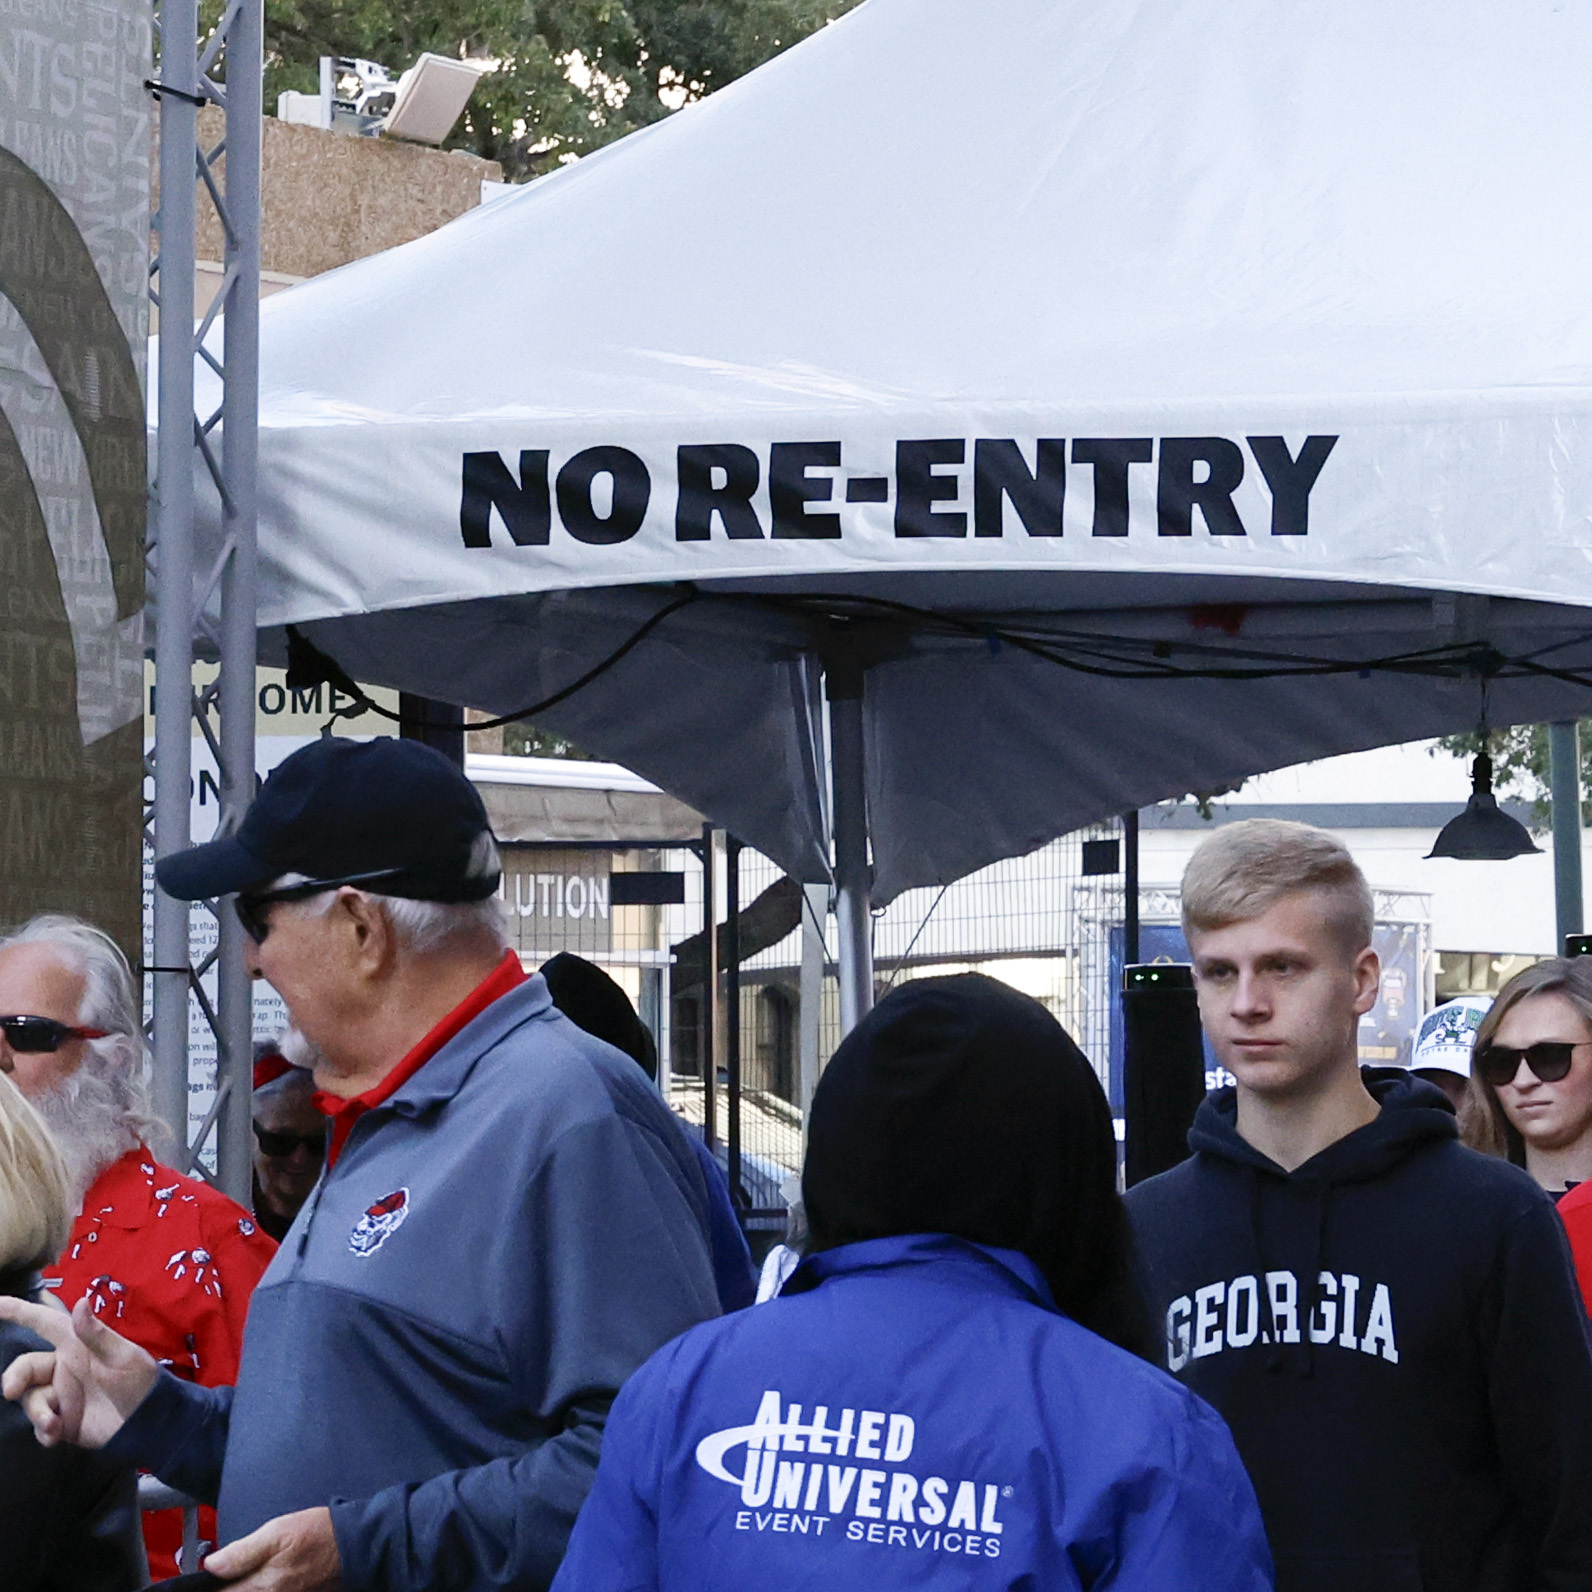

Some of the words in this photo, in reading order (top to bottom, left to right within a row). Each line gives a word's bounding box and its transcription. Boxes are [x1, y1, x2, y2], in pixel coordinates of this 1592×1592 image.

[461, 446, 651, 547] NO
[675, 434, 1339, 541] RE-ENTRY
[500, 872, 609, 919] LUTION
[1166, 1270, 1399, 1373] GEORGIA
[746, 1391, 915, 1462] ALLIED
[741, 1448, 1003, 1534] UNIVERSAL
[735, 1511, 831, 1535] EVENT
[846, 1521, 1001, 1558] SERVICES
